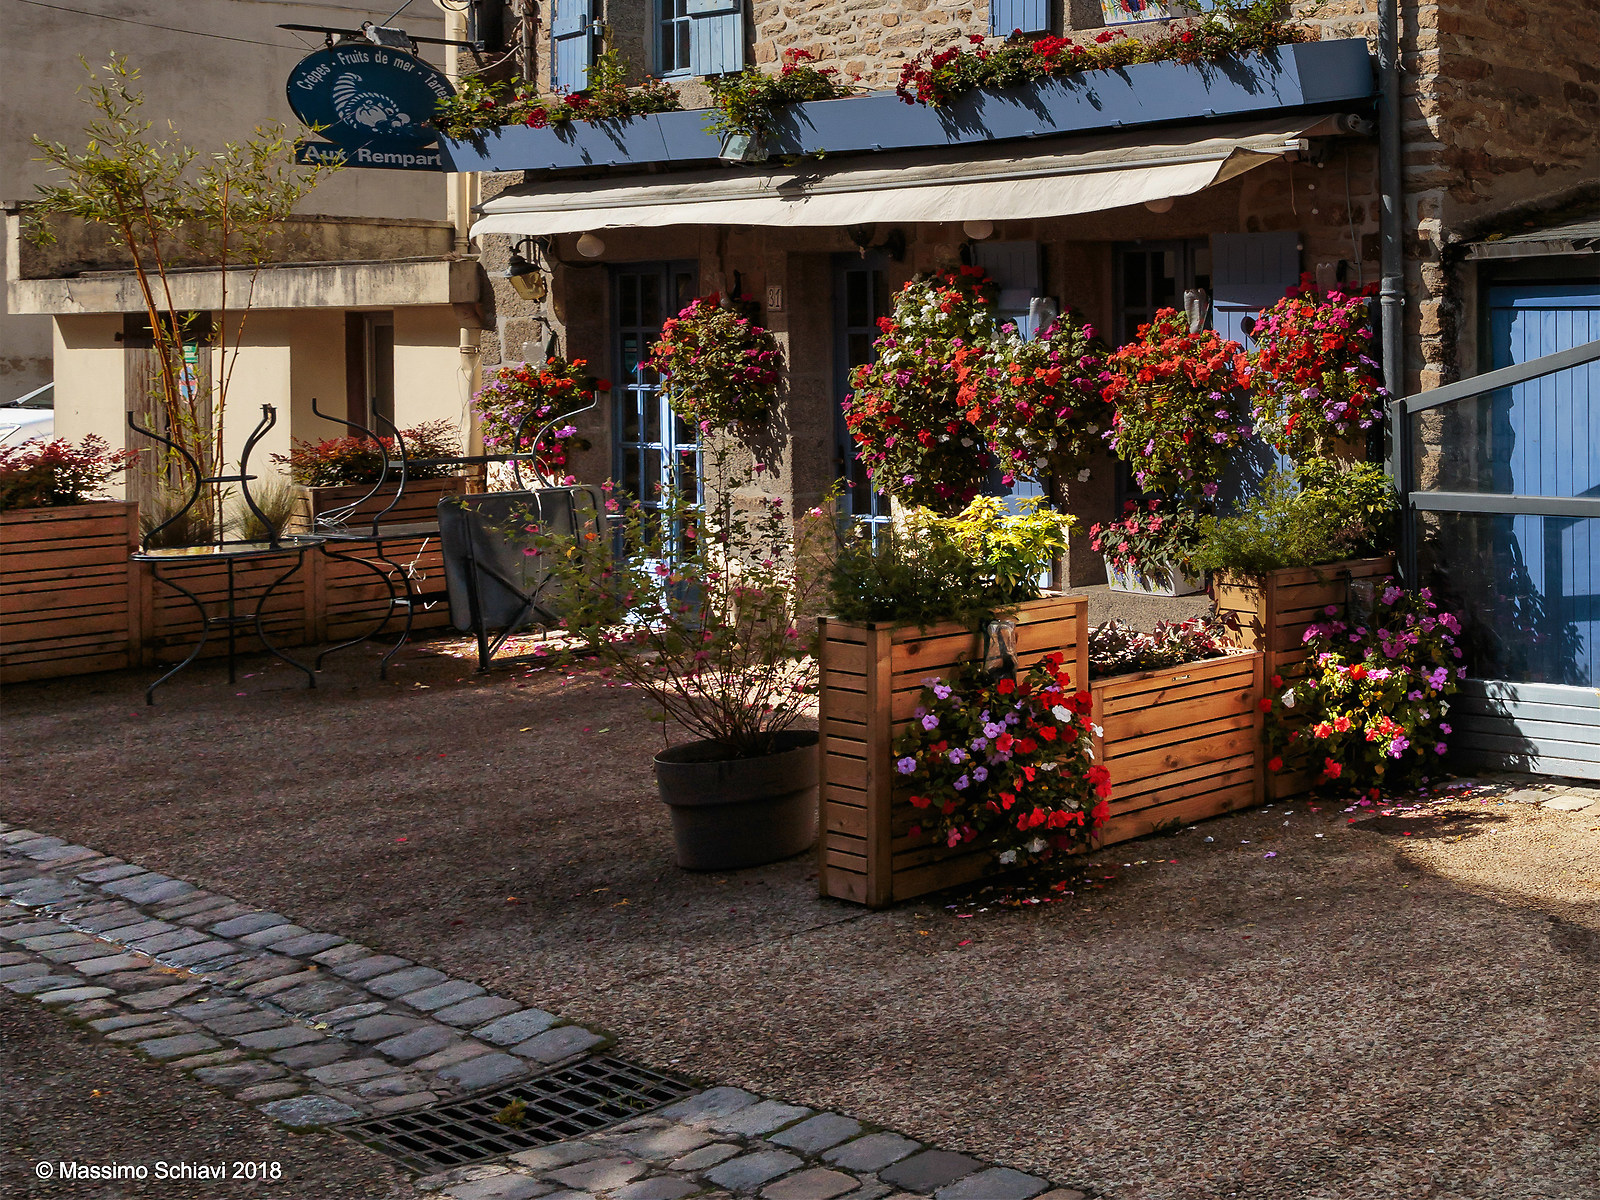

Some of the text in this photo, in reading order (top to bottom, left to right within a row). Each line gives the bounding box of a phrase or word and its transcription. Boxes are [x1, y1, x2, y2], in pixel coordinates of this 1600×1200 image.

[337, 50, 370, 65] Fruits
[374, 50, 388, 65] de
[393, 57, 416, 73] mer
[301, 145, 347, 162] Aux
[768, 288, 780, 307] 31
